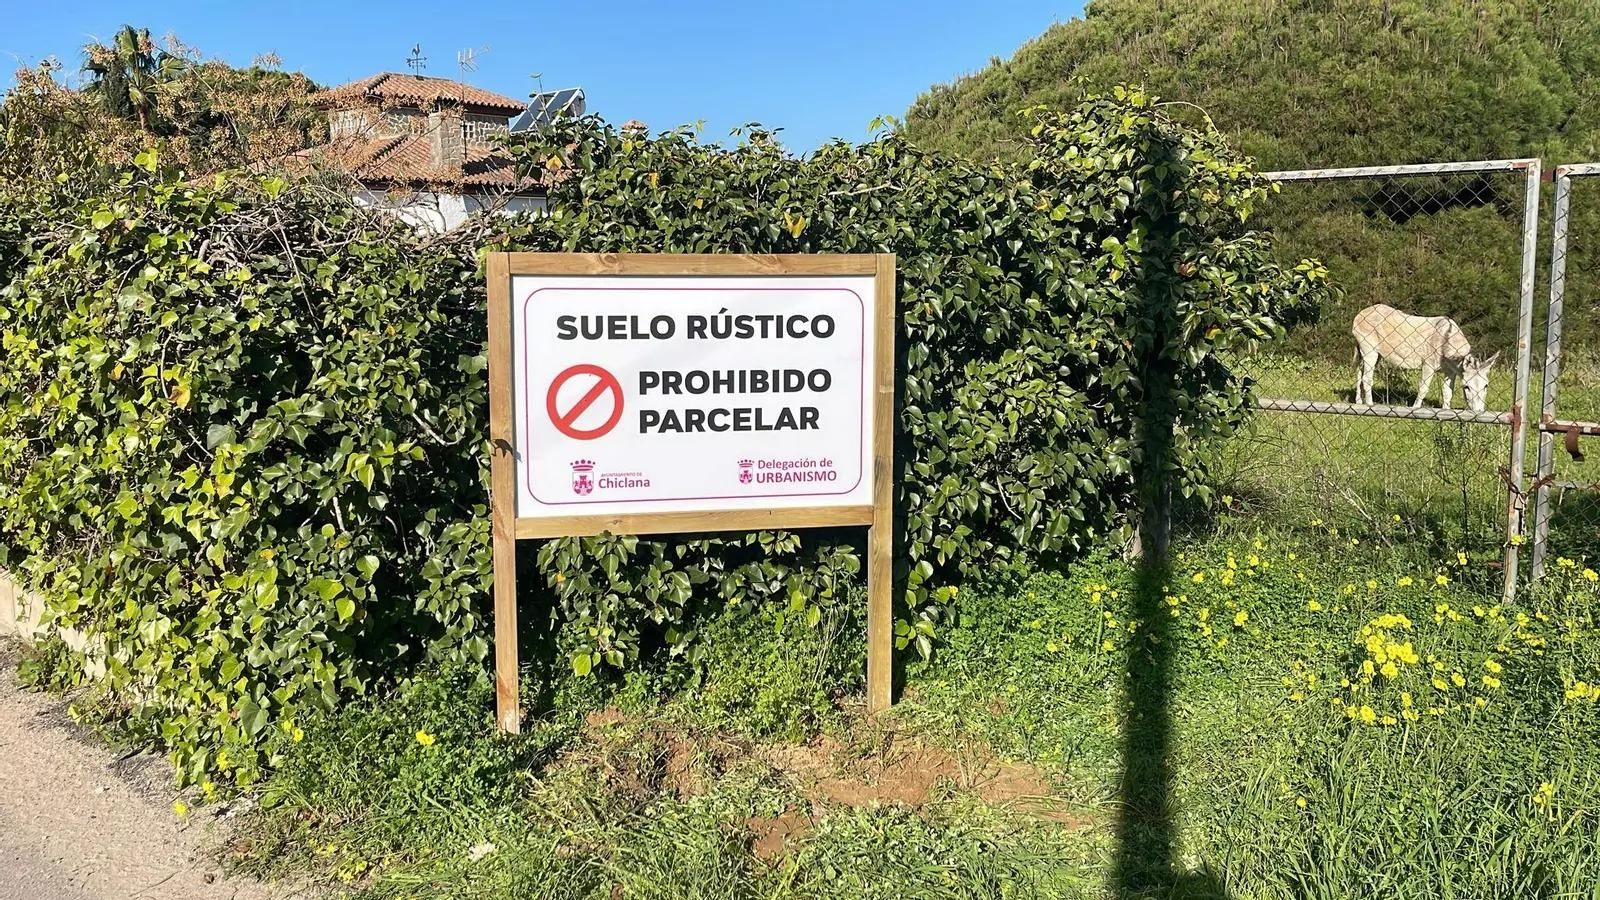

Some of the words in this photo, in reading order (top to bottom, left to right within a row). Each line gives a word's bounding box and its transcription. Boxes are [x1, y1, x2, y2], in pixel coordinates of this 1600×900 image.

[556, 314, 676, 341] SUELO
[686, 307, 836, 340] RÚSTICO
[639, 368, 832, 396] PROHIBIDO
[639, 406, 820, 434] PARCELAR
[757, 458, 817, 470] Delegación
[819, 458, 833, 467] de
[598, 478, 650, 489] Chiclana
[756, 470, 837, 484] URBANISMO
